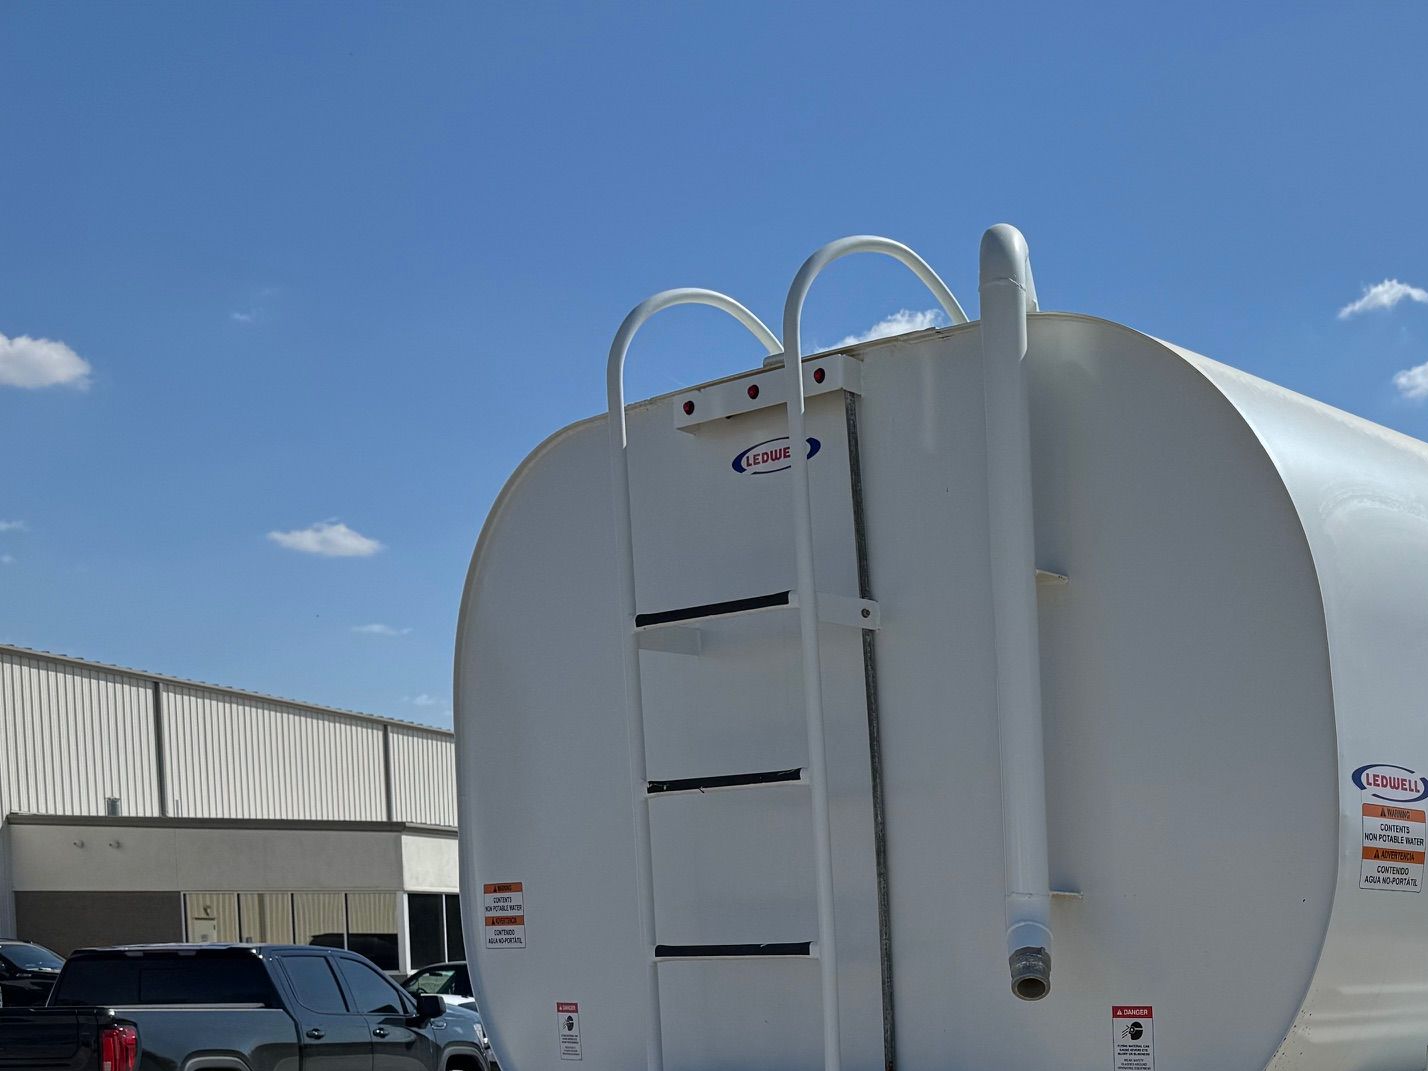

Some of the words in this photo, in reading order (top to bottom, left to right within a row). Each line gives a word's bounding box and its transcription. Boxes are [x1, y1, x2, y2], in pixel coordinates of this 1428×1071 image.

[746, 446, 791, 468] LEDWE
[1365, 773, 1420, 793] LEDWELL
[1387, 808, 1411, 819] WARNING
[1380, 823, 1410, 834] CONTENTS
[1364, 832, 1377, 841] NON
[1379, 834, 1404, 844] POTABLE
[1405, 837, 1424, 846] WATER
[1376, 865, 1409, 876] CONTENIDO
[1364, 875, 1381, 884] AGUA
